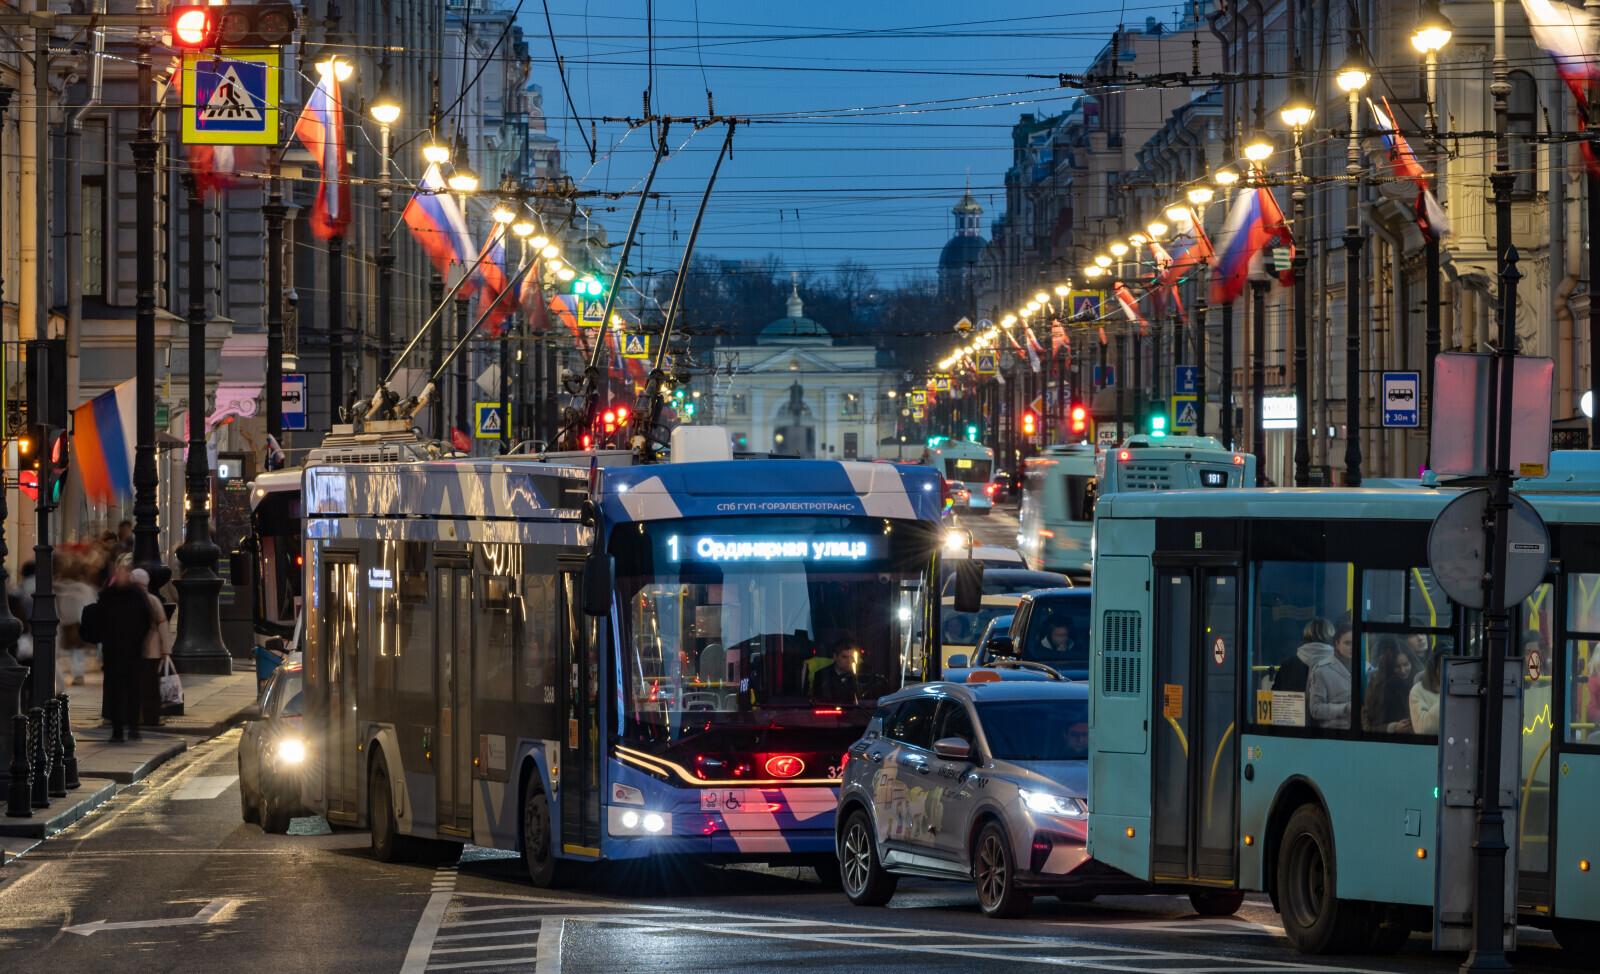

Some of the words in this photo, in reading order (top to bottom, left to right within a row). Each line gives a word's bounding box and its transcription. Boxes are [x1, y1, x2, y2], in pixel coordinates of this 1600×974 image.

[1208, 473, 1220, 485] 191
[738, 502, 757, 511] ГУП
[668, 534, 679, 560] 1
[697, 538, 808, 561] Ординарная
[812, 541, 867, 561] улица
[1258, 700, 1272, 720] 191
